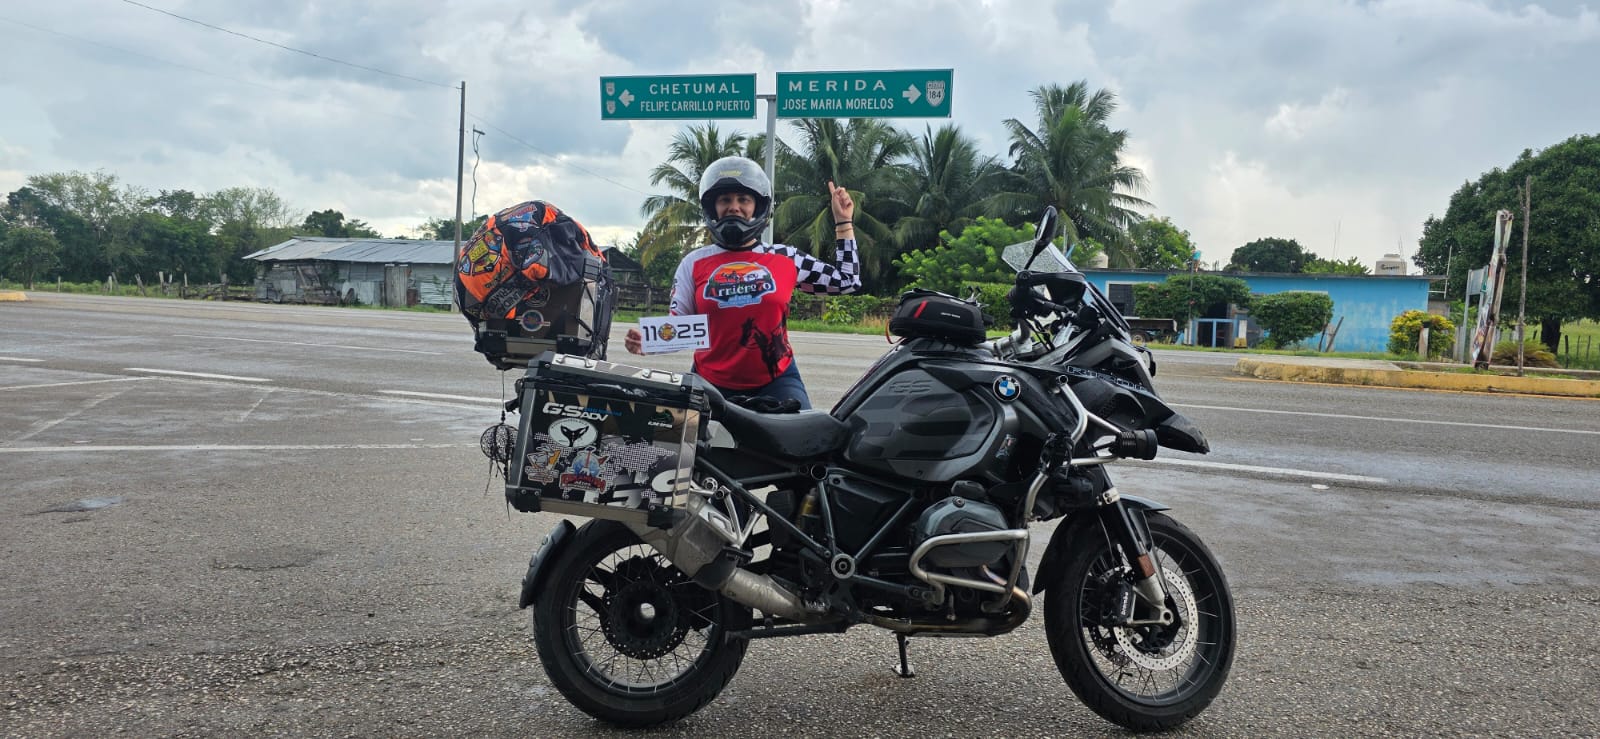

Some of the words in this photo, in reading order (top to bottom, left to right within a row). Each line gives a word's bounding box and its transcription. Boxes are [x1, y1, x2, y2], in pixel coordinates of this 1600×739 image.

[649, 82, 740, 95] CHETUMAL
[788, 79, 886, 92] MERIDA
[929, 90, 941, 99] 184
[640, 100, 669, 112] FELIPE
[671, 100, 714, 112] CARRILLO
[716, 99, 750, 111] PUERTO
[782, 98, 807, 111] JOSE
[810, 98, 842, 110] MARIA
[846, 98, 894, 110] MORELOS
